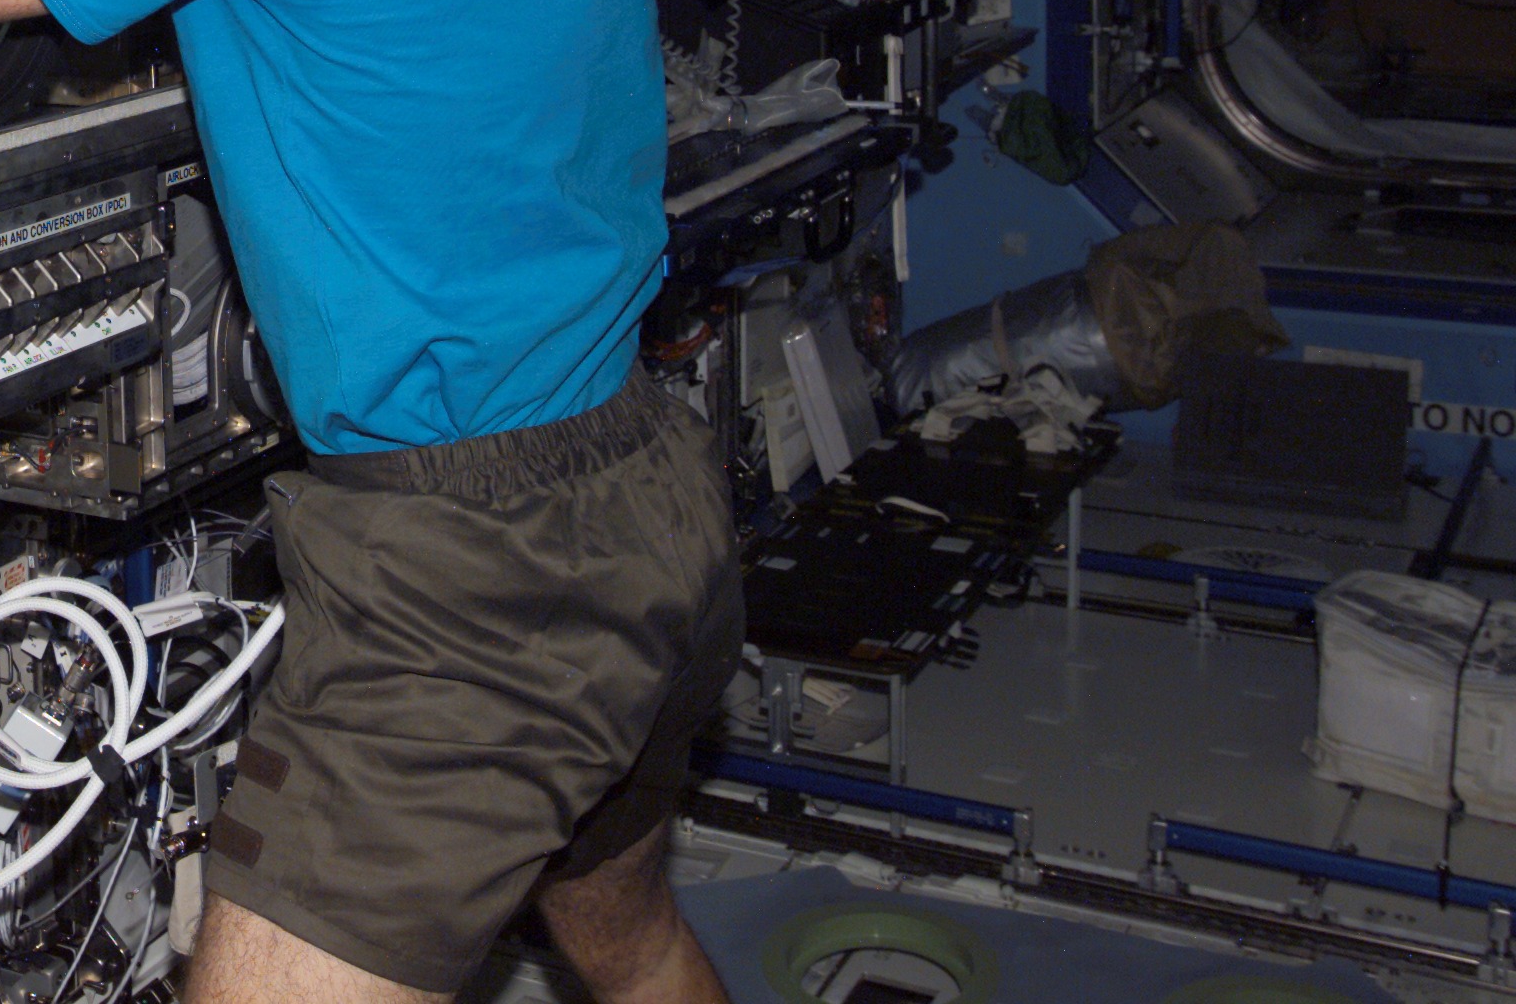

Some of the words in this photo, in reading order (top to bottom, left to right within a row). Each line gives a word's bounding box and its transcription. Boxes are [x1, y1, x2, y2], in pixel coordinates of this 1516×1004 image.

[167, 165, 198, 184] AIRLOCK
[10, 228, 28, 244] AND
[30, 211, 84, 237] CONVERSION
[86, 203, 104, 220] BOX
[105, 196, 128, 215] (PDC)
[1462, 406, 1516, 438] NO
